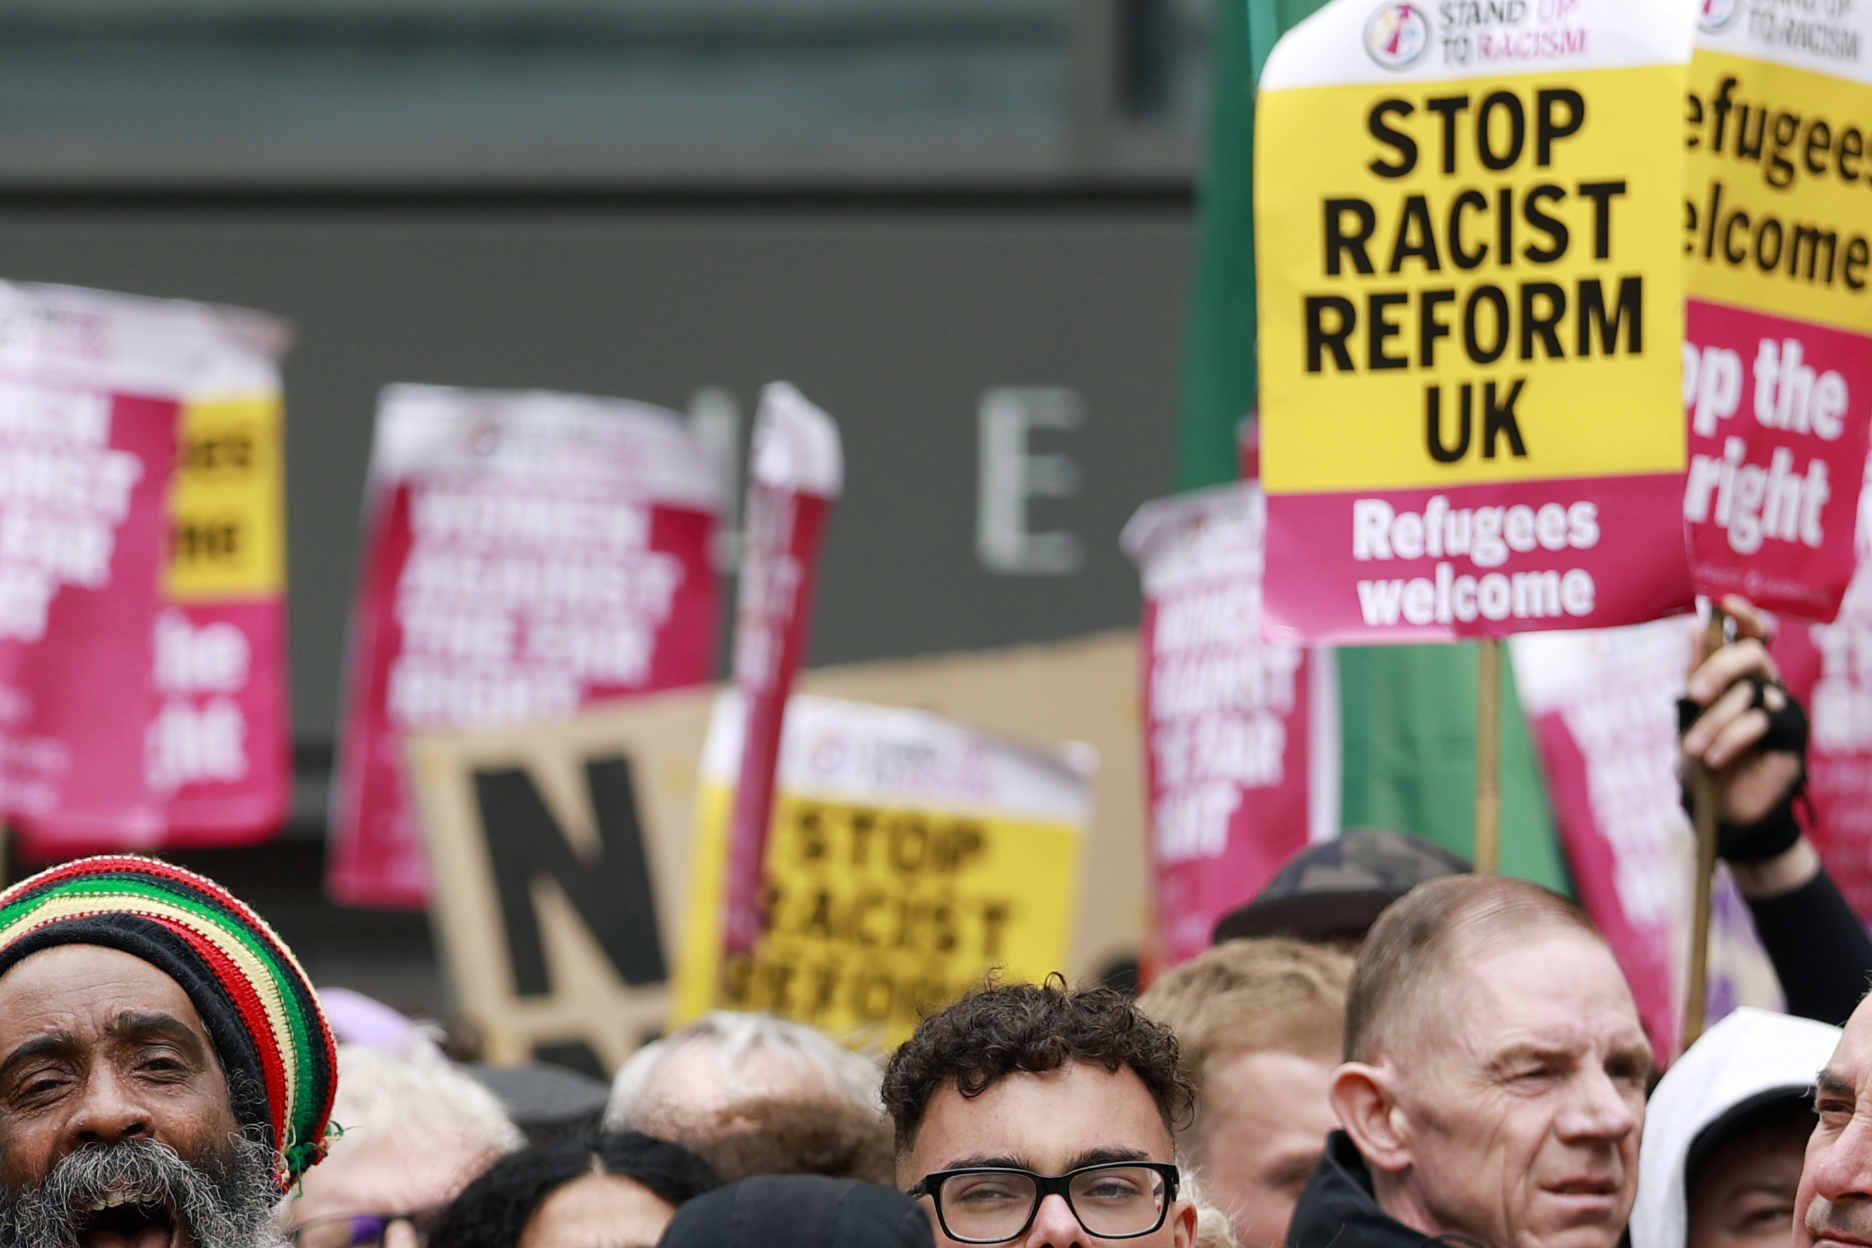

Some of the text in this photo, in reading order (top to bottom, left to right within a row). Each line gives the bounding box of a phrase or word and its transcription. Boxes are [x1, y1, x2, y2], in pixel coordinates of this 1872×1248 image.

[1442, 29, 1588, 66] TO RACISM
[1366, 87, 1586, 179] STOP
[1685, 75, 1872, 189] efugee
[1322, 180, 1628, 277] RACIST
[1684, 182, 1872, 291] elcome
[1302, 276, 1645, 373] REFORM
[1425, 379, 1530, 464] UK
[1753, 338, 1850, 440] the
[1352, 497, 1601, 569] Refugees
[1685, 438, 1832, 556] right
[1356, 563, 1597, 627] welcome
